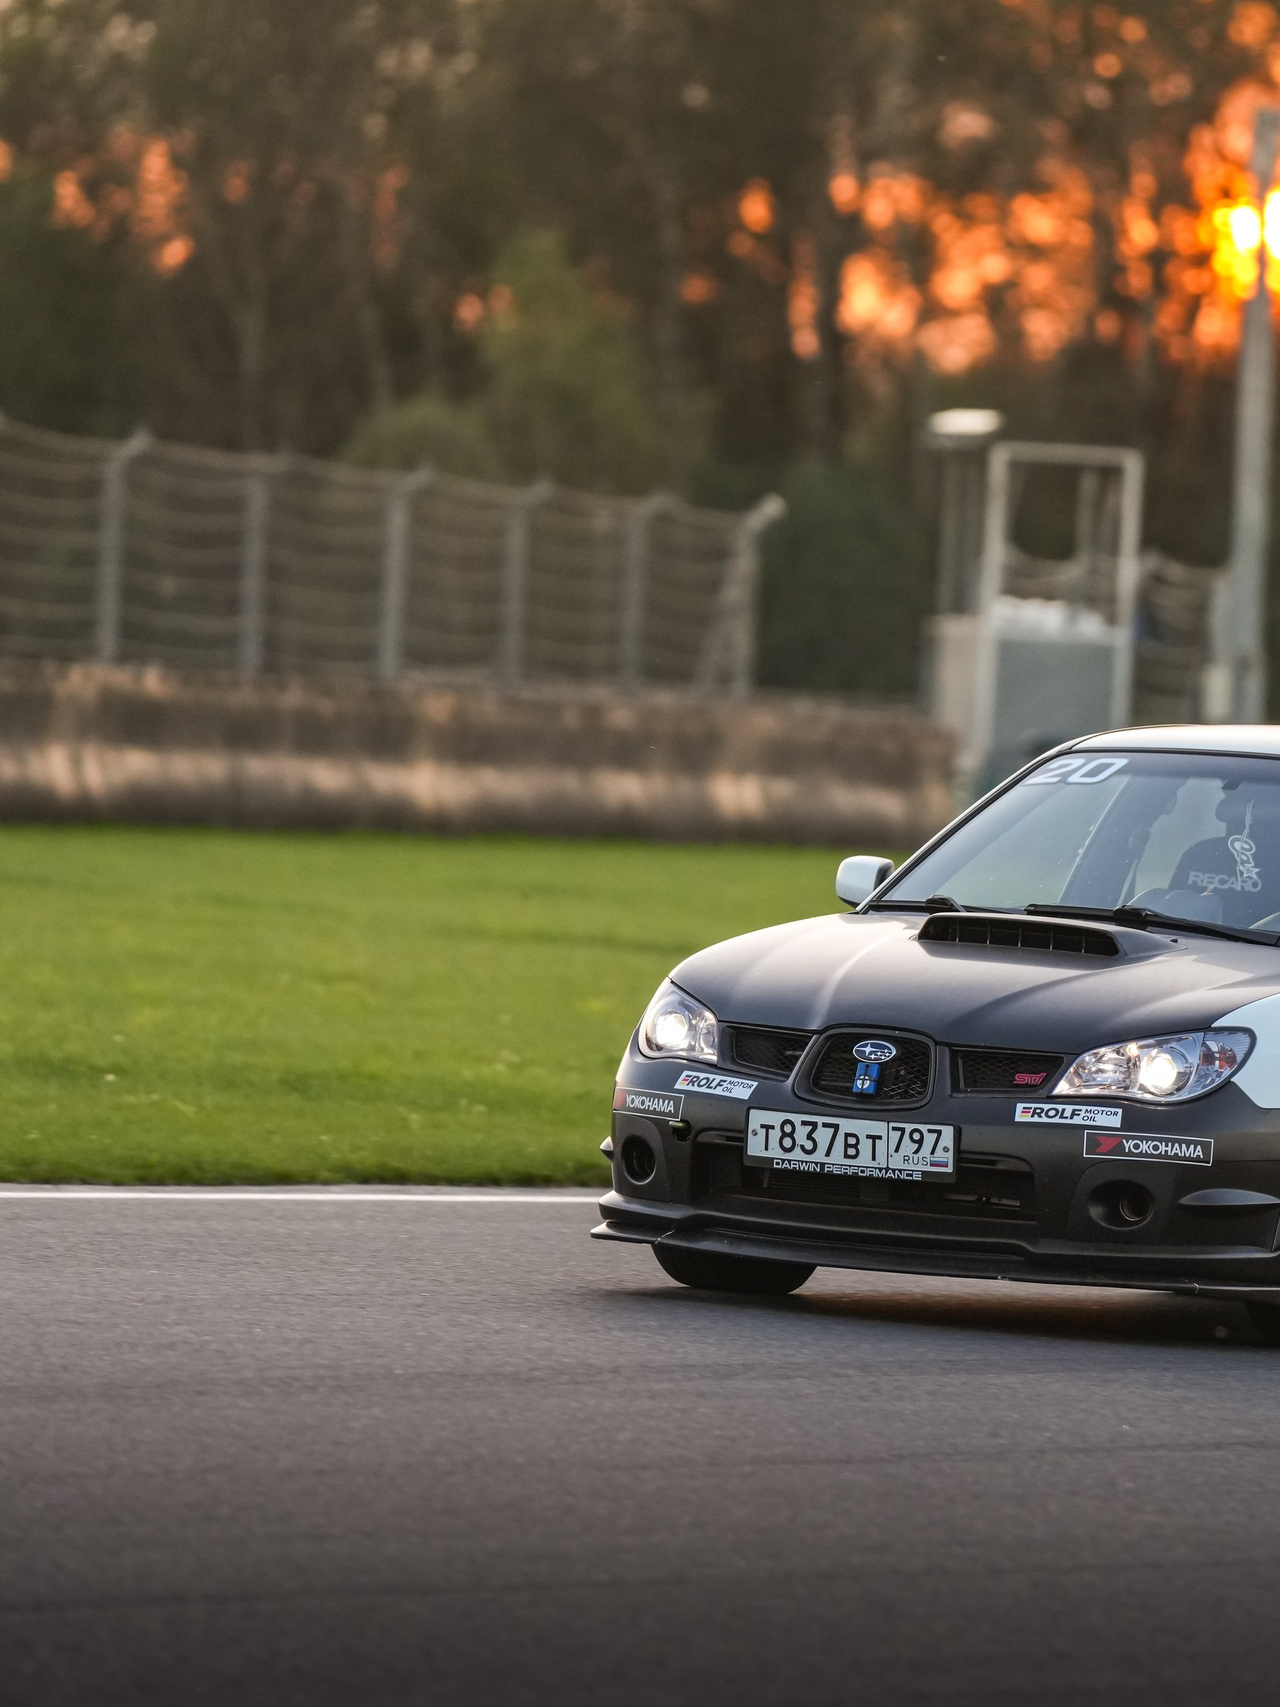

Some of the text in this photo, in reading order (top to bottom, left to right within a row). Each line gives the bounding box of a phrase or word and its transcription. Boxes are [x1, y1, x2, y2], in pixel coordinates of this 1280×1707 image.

[1022, 758, 1130, 785] 20
[1188, 871, 1262, 892] RECARO
[687, 1075, 754, 1090] ROLF MOTOR
[722, 1086, 733, 1094] OIL
[626, 1094, 675, 1114] YOKOHAMA
[1030, 1106, 1119, 1120] ROLF MOTOR
[1081, 1114, 1097, 1123] OIL
[891, 1126, 943, 1156] 797
[1122, 1139, 1204, 1159] YOKOHAMA
[773, 1159, 922, 1181] DARWIN PERFORMANCE
[902, 1155, 929, 1166] RUS
